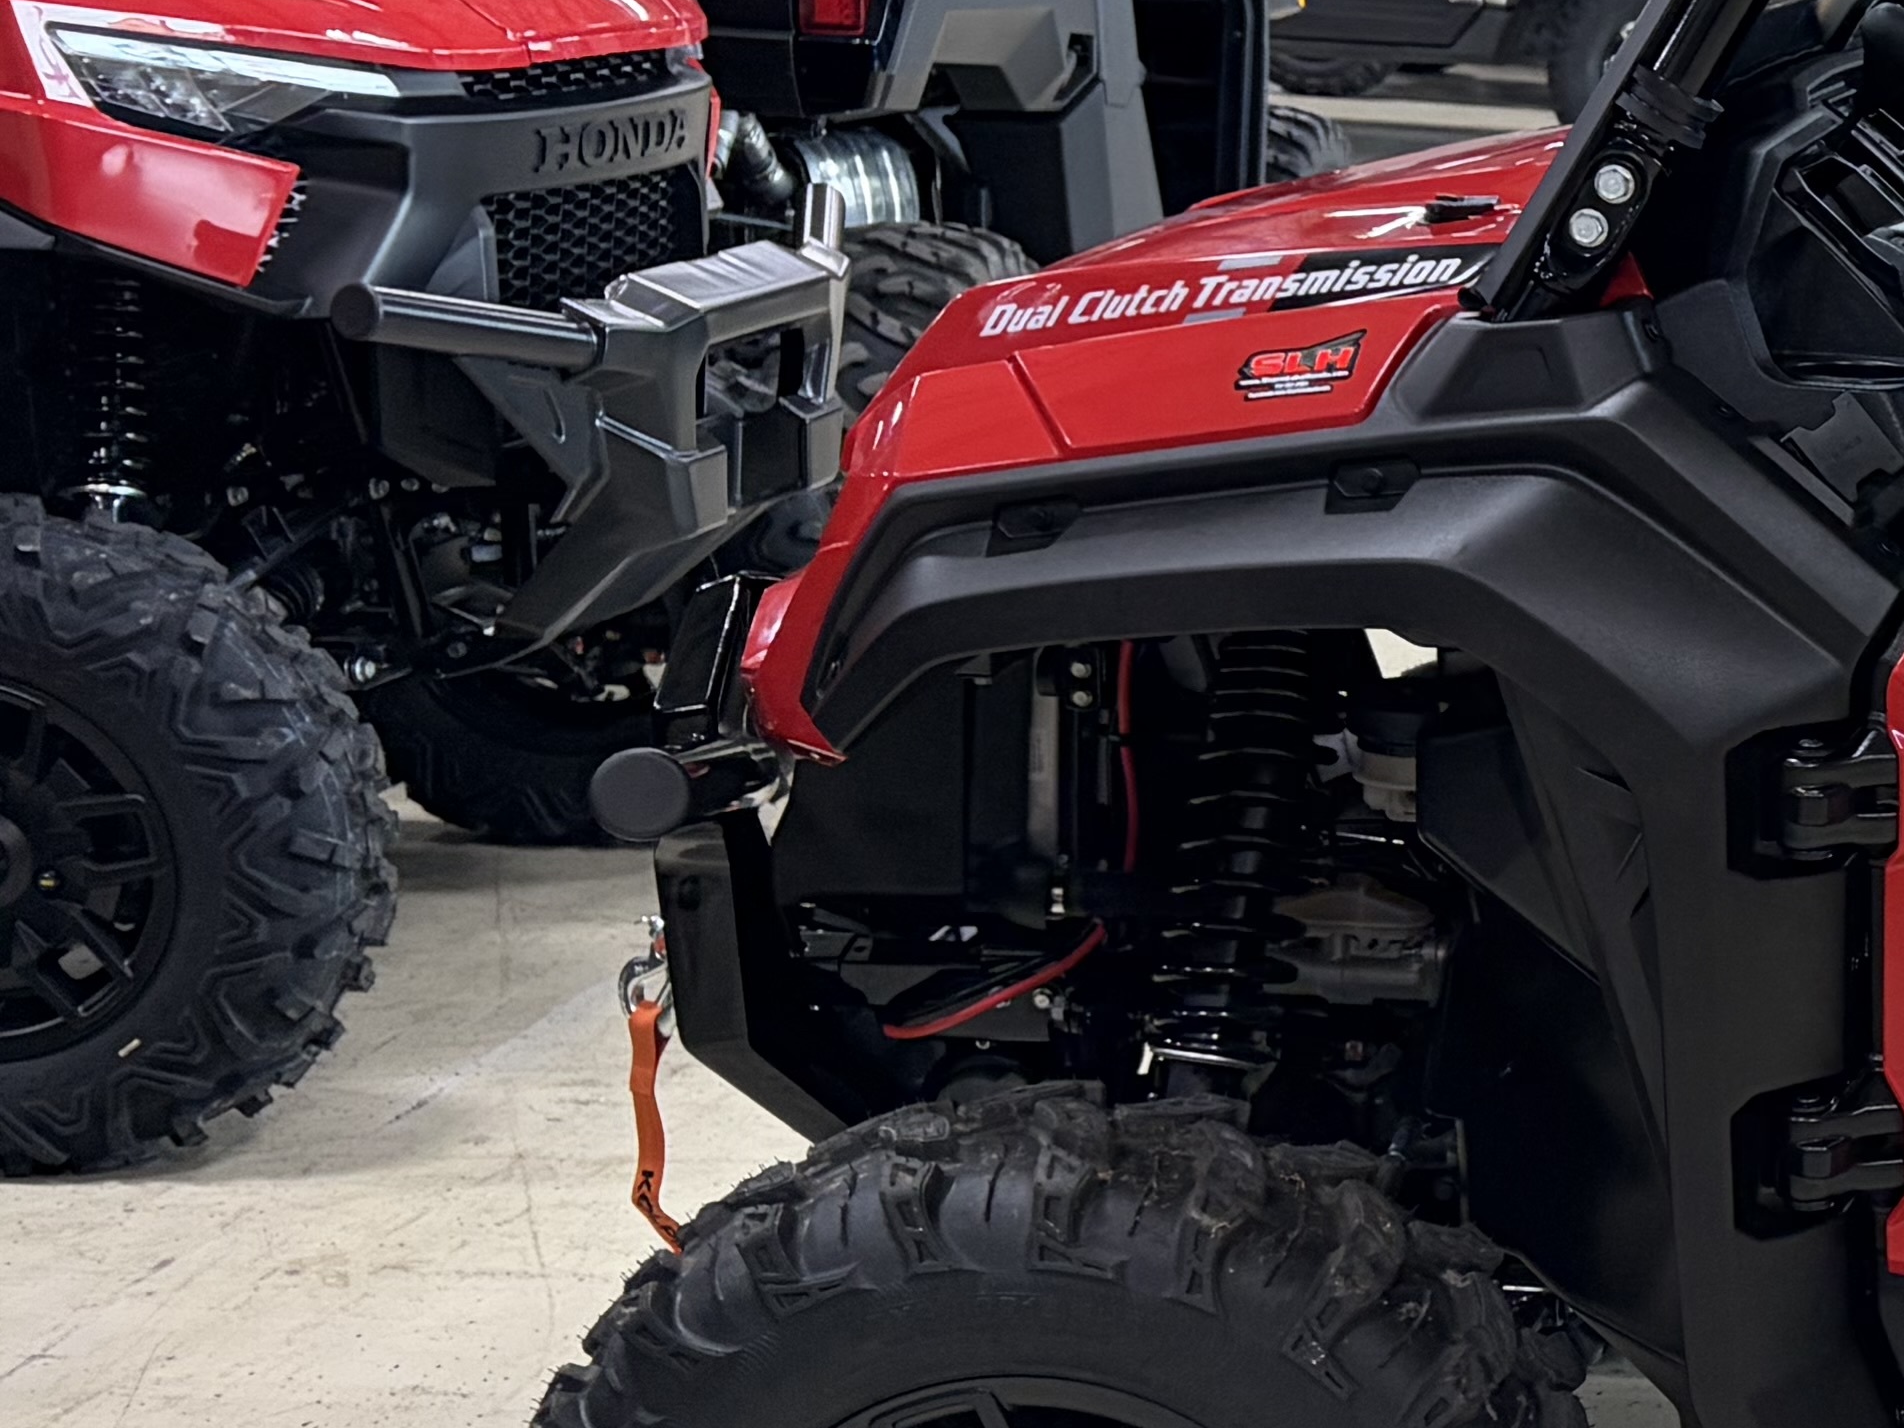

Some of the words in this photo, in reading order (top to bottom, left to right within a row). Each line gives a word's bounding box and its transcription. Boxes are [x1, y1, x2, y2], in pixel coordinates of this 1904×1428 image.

[534, 108, 688, 173] HONDA
[979, 295, 1070, 338] Dual
[1067, 280, 1189, 325] Clutch
[1192, 254, 1462, 309] Transmission
[1250, 346, 1355, 377] SLH
